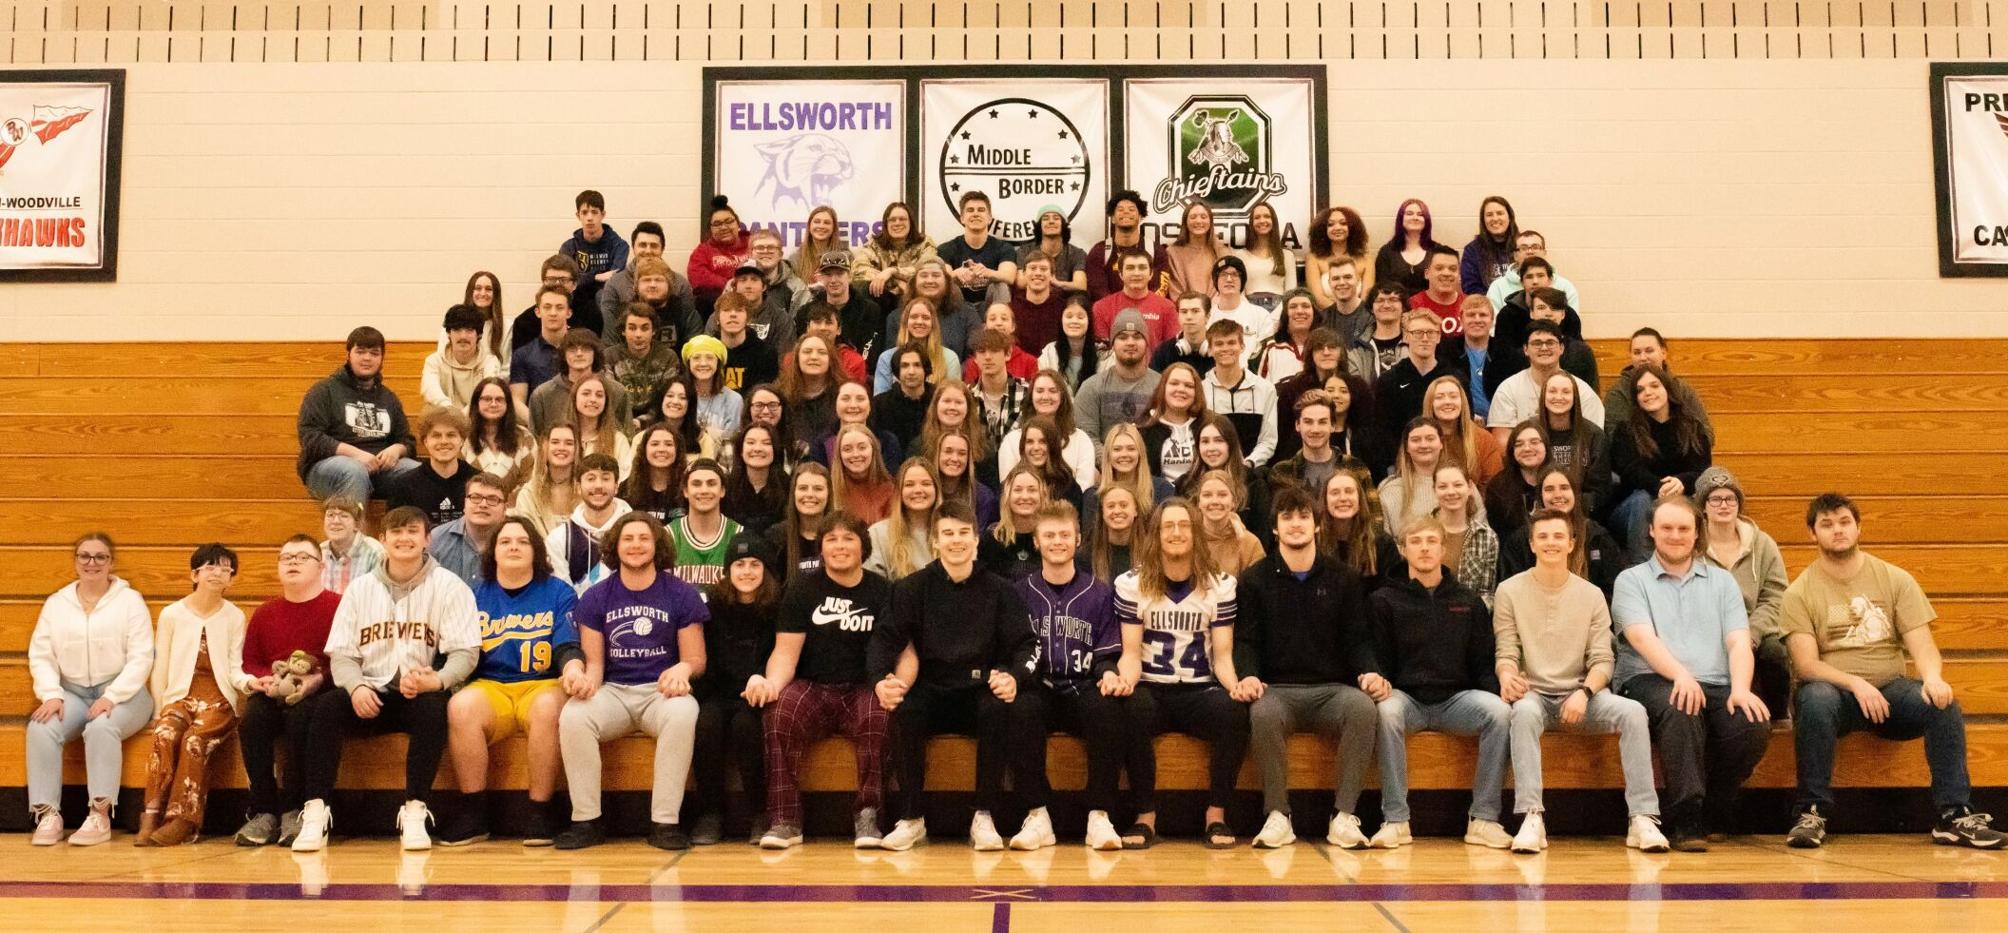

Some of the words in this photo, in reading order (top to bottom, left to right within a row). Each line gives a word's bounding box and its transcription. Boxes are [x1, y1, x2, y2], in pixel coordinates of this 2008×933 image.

[730, 102, 892, 130] ELLSWORTH
[968, 144, 1031, 165] MIDDLE
[998, 178, 1065, 199] BORDER
[1154, 165, 1287, 214] Chieftains
[0, 197, 81, 208] -WOODVILLE
[0, 217, 85, 247] HAWKS
[726, 367, 745, 389] AT
[673, 565, 726, 585] MILWAUKE
[606, 605, 669, 624] ELLSWORTH
[821, 596, 853, 614] JUST
[479, 610, 554, 637] Brewers
[1150, 610, 1202, 631] ELLSWORTH
[520, 640, 552, 673] 19
[1071, 649, 1094, 673] 34
[1141, 629, 1211, 678] 34
